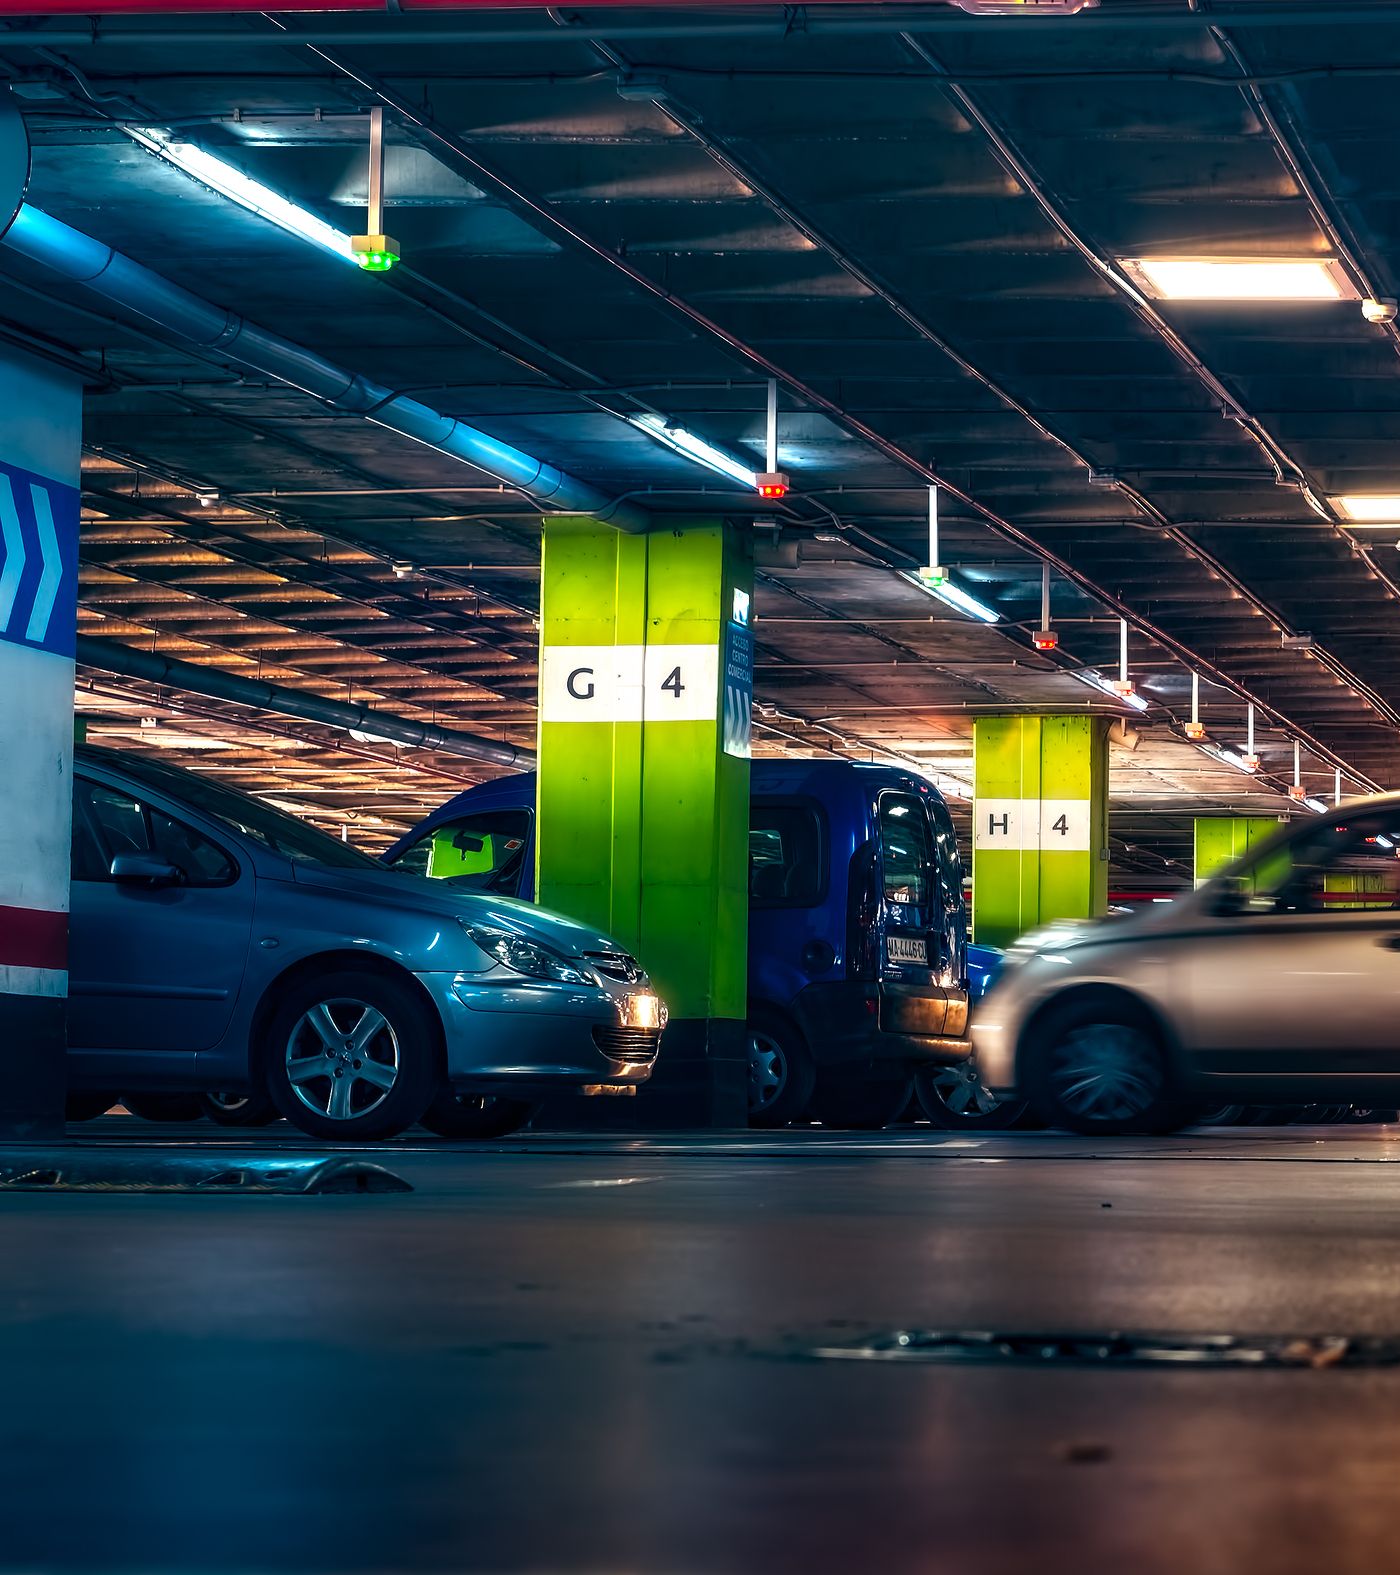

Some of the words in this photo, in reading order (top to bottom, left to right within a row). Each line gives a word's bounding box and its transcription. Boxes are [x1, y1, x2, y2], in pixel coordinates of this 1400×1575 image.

[731, 649, 749, 667] CENTRO
[566, 667, 595, 700] G
[660, 666, 686, 698] 4
[727, 662, 752, 684] COMERCIAL
[988, 813, 1009, 836] H
[1051, 813, 1070, 836] 4
